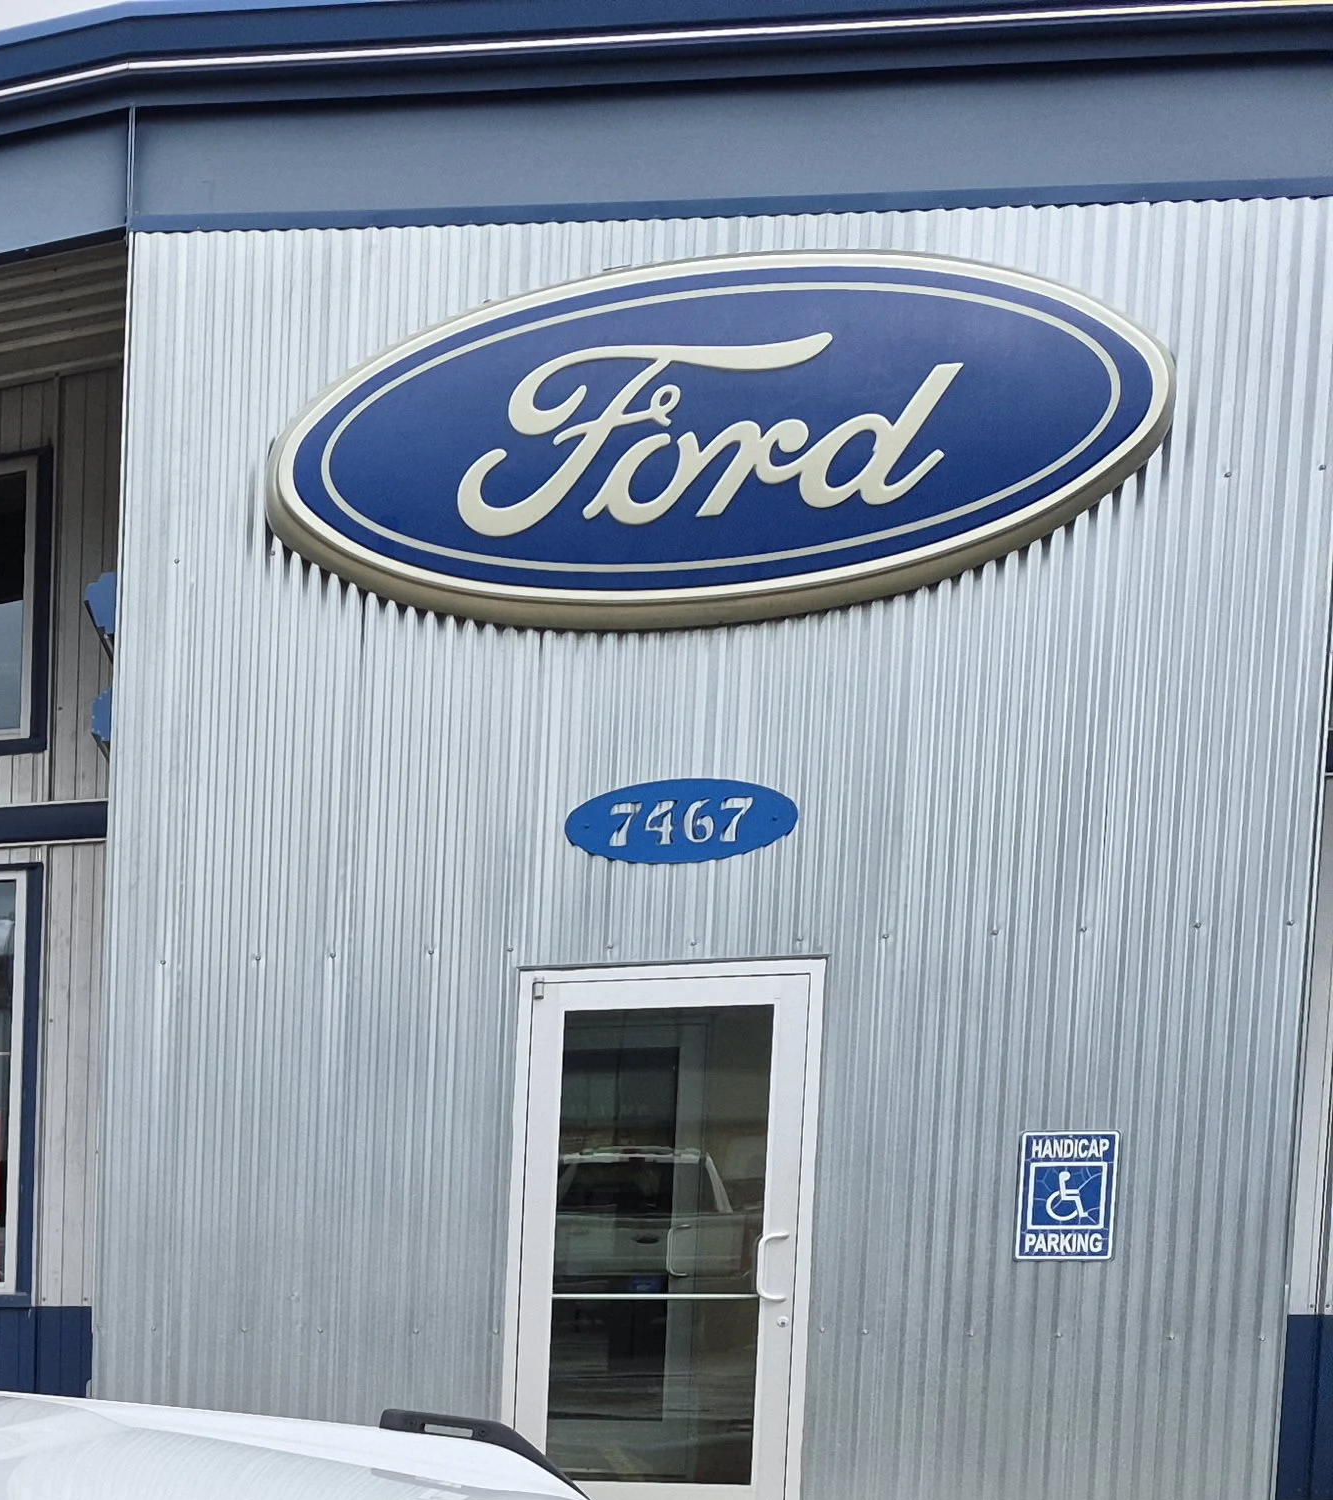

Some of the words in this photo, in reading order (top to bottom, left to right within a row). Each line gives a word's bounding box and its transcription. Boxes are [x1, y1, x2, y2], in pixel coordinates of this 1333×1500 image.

[457, 330, 964, 538] Ford
[609, 796, 754, 847] 7467
[1031, 1138, 1110, 1159] HANDICAP
[1024, 1232, 1103, 1253] PARKING
